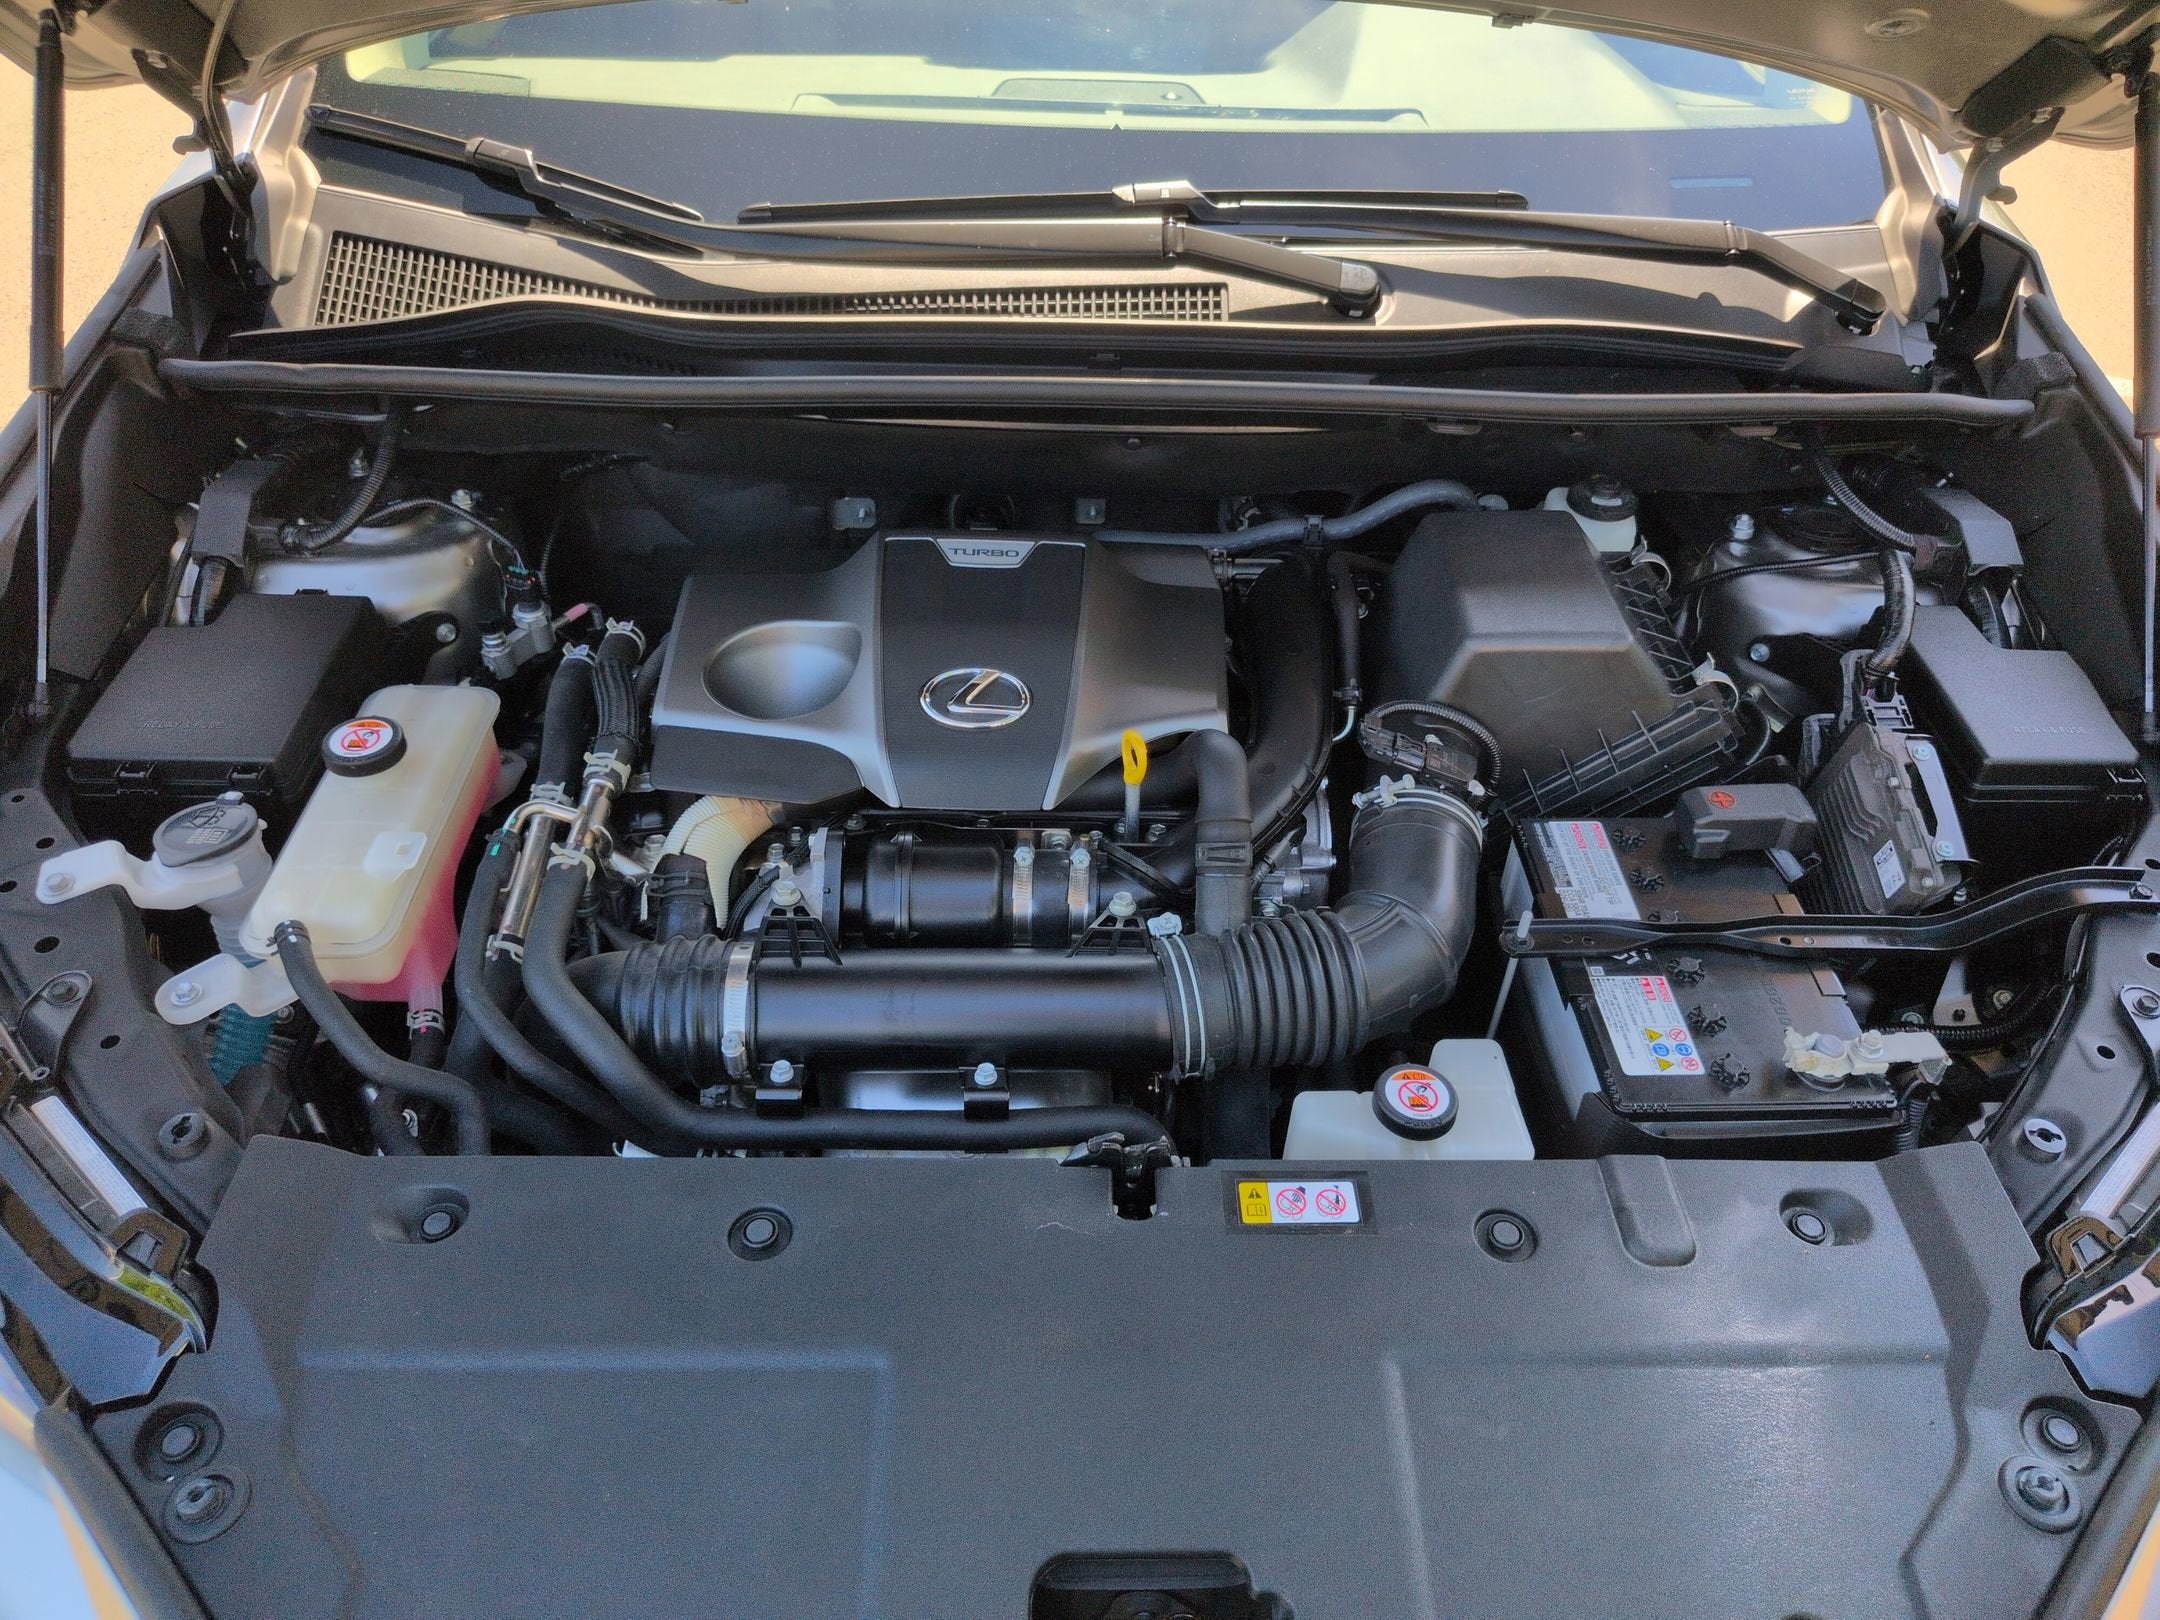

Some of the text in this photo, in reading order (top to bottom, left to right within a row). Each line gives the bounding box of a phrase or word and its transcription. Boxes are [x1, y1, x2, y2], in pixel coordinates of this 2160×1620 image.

[948, 547, 1020, 558] TURBO
[2012, 726, 2046, 735] RELAY
[2057, 726, 2088, 735] FUSE
